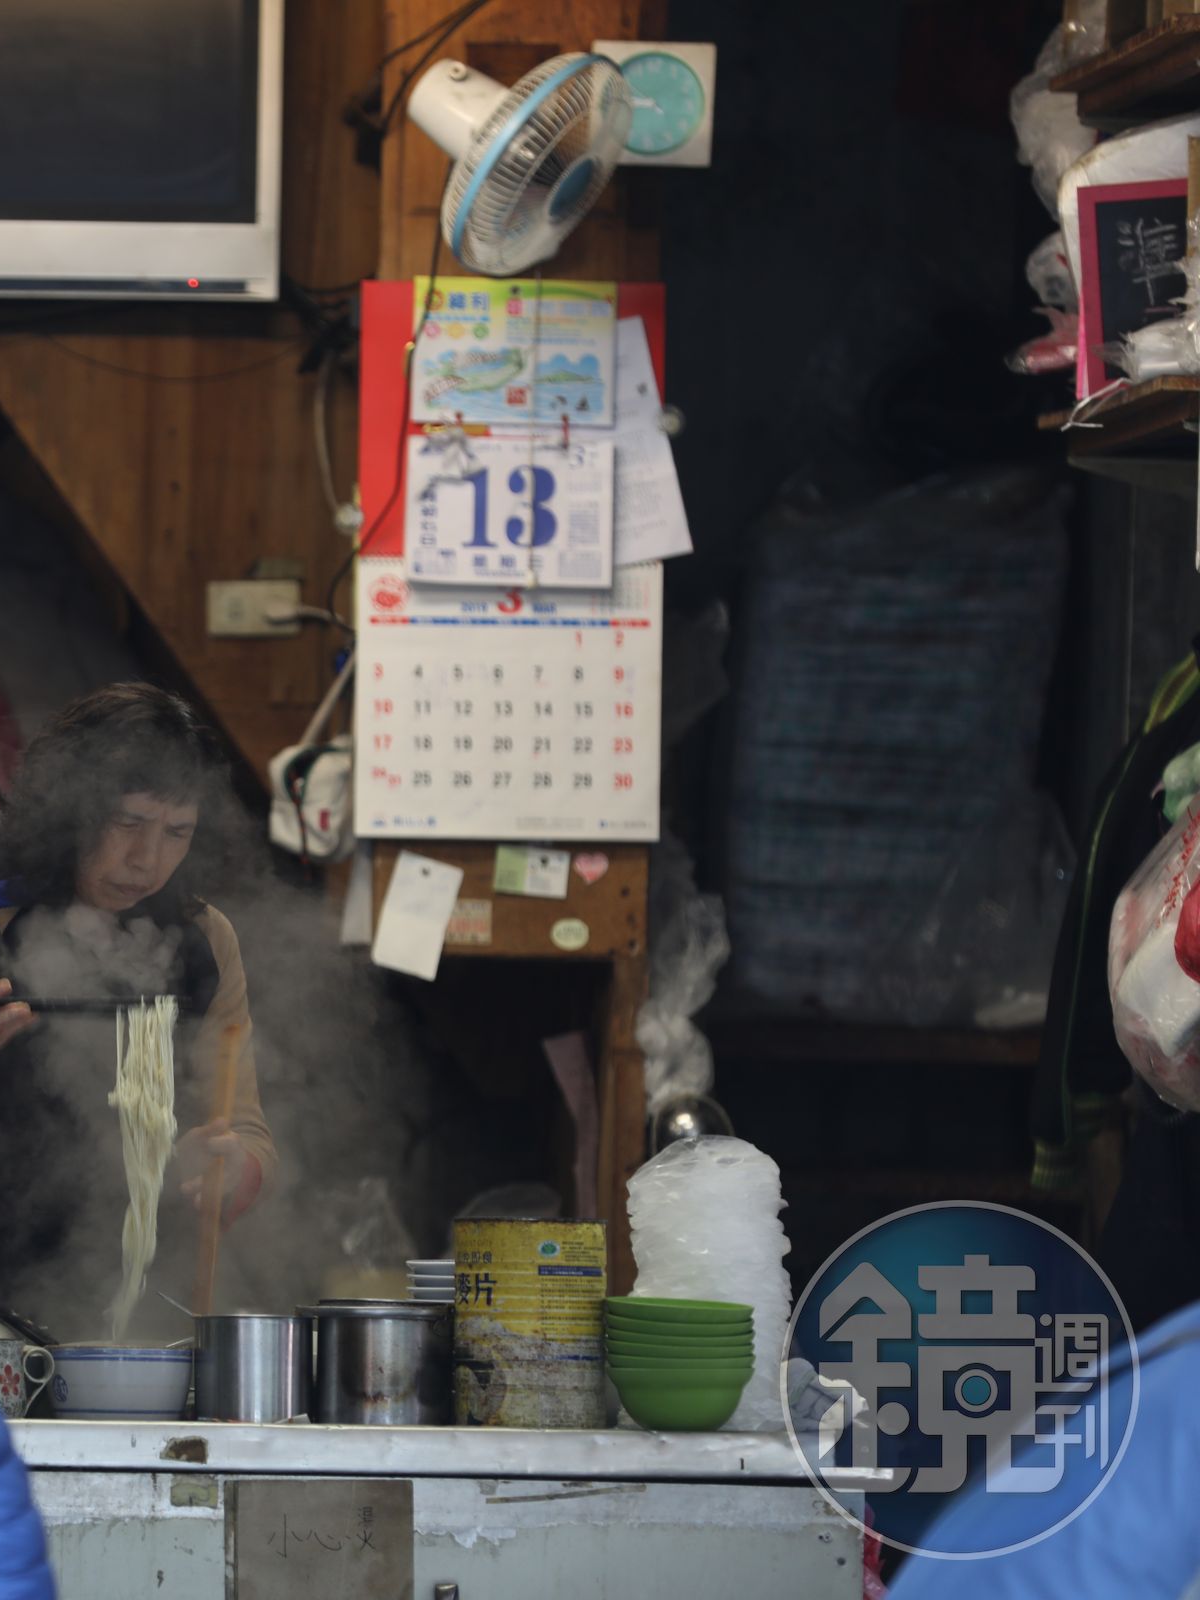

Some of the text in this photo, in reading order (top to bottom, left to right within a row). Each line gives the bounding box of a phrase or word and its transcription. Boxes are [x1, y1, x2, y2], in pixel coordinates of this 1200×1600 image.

[462, 465, 558, 549] 13
[374, 699, 634, 717] 10 11 12 13 14 15 16
[374, 733, 633, 755] 17 18 19 20 21 22 23
[412, 770, 433, 787] 25
[453, 772, 473, 787] 26
[492, 771, 512, 788] 27
[532, 772, 553, 788] 28
[573, 773, 593, 789] 29
[613, 773, 633, 789] 30
